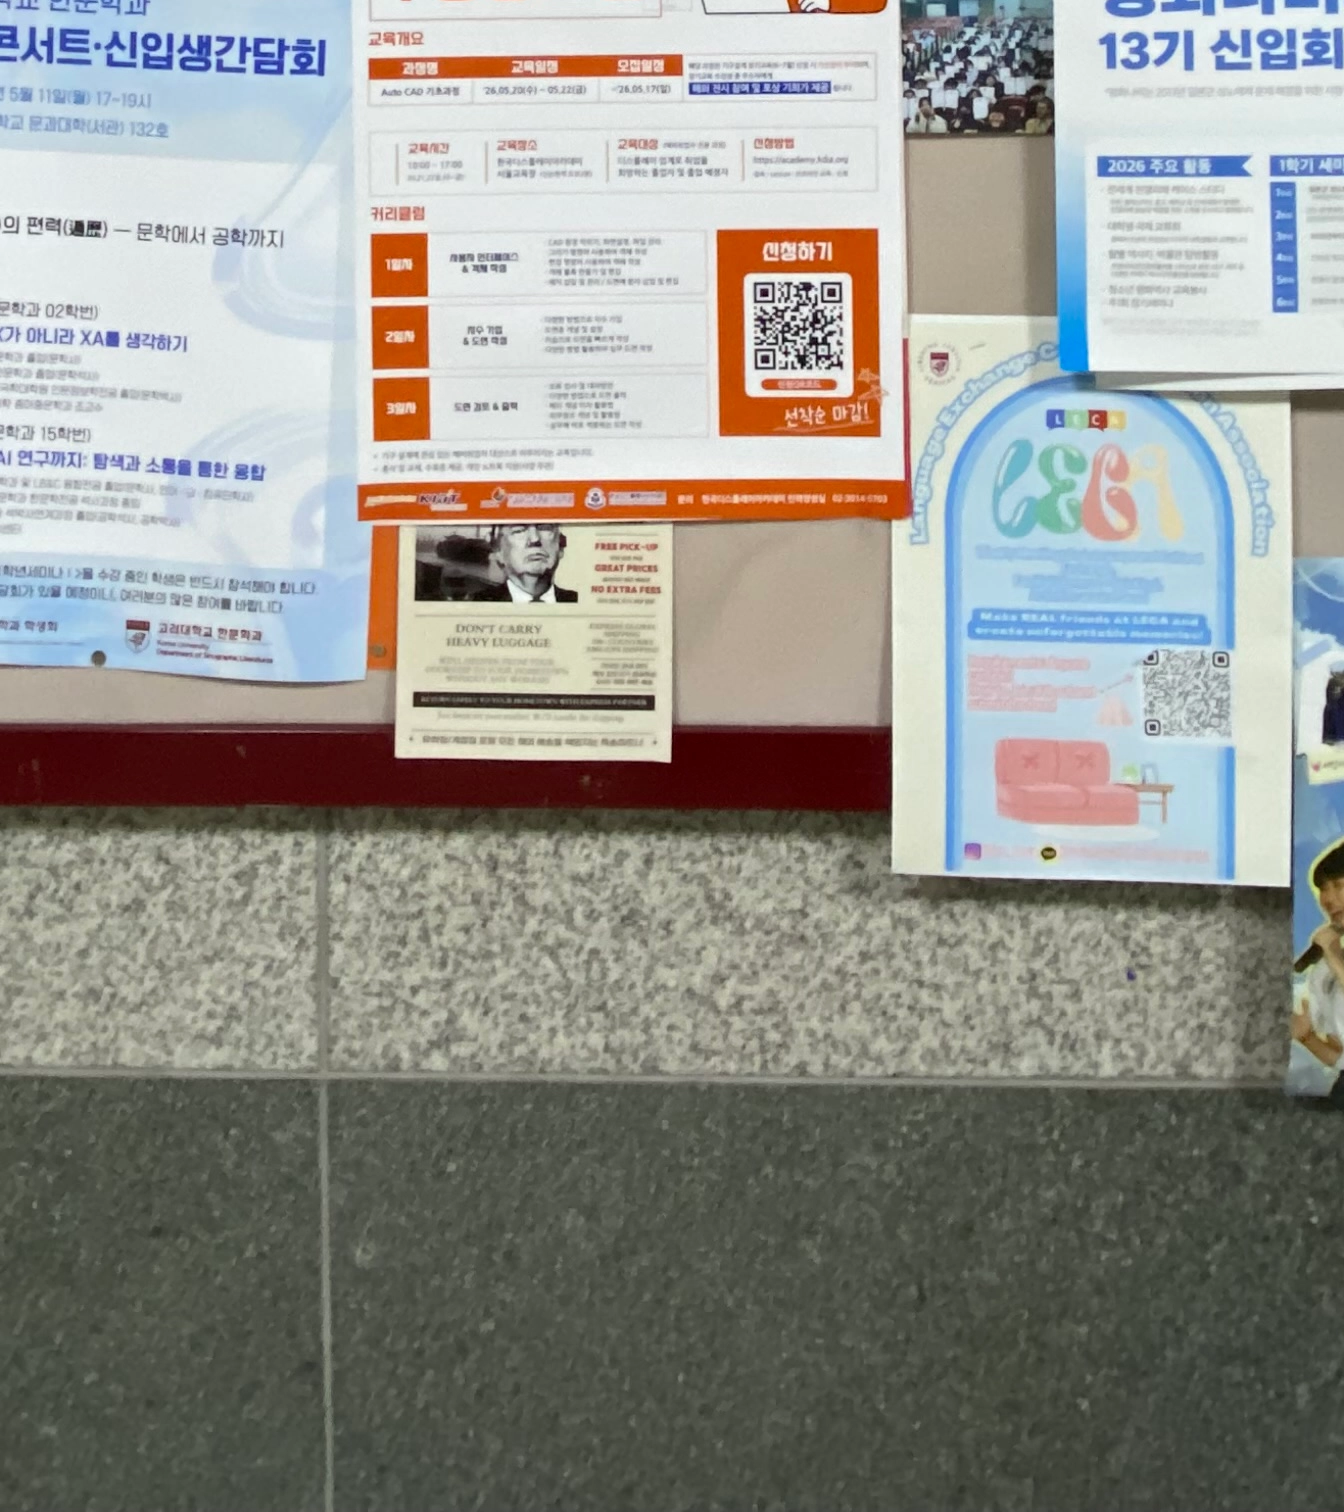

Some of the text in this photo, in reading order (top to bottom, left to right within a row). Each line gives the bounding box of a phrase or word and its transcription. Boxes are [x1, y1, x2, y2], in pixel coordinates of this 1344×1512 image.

[368, 32, 424, 46] 교육개요
[1098, 31, 1195, 72] 13기
[402, 59, 664, 75] 과정명 교육일정 모집일정
[408, 140, 537, 154] 교육시간 교육장소
[618, 138, 795, 150] 교육대상 신청방법
[1107, 158, 1211, 174] 2026 주요 활동
[1279, 158, 1314, 173] 1학기
[371, 206, 425, 221] 커리큘럼
[136, 222, 285, 249] 문학에서 공학까지
[761, 242, 832, 263] 신청하기
[26, 328, 74, 346] 아니라
[126, 332, 188, 352] 생각하기
[784, 402, 869, 427] 선착순 마감!
[41, 426, 92, 443] 15학번)
[93, 453, 140, 471] 탐색과
[595, 542, 617, 550] FREE
[594, 564, 658, 572] GREAT PRICES
[591, 586, 661, 594] NO EXTRA FEES
[159, 622, 212, 637] 고려대학교
[456, 624, 543, 634] DON'T CARRY
[446, 638, 552, 648] HEAVY LUGGAGE
